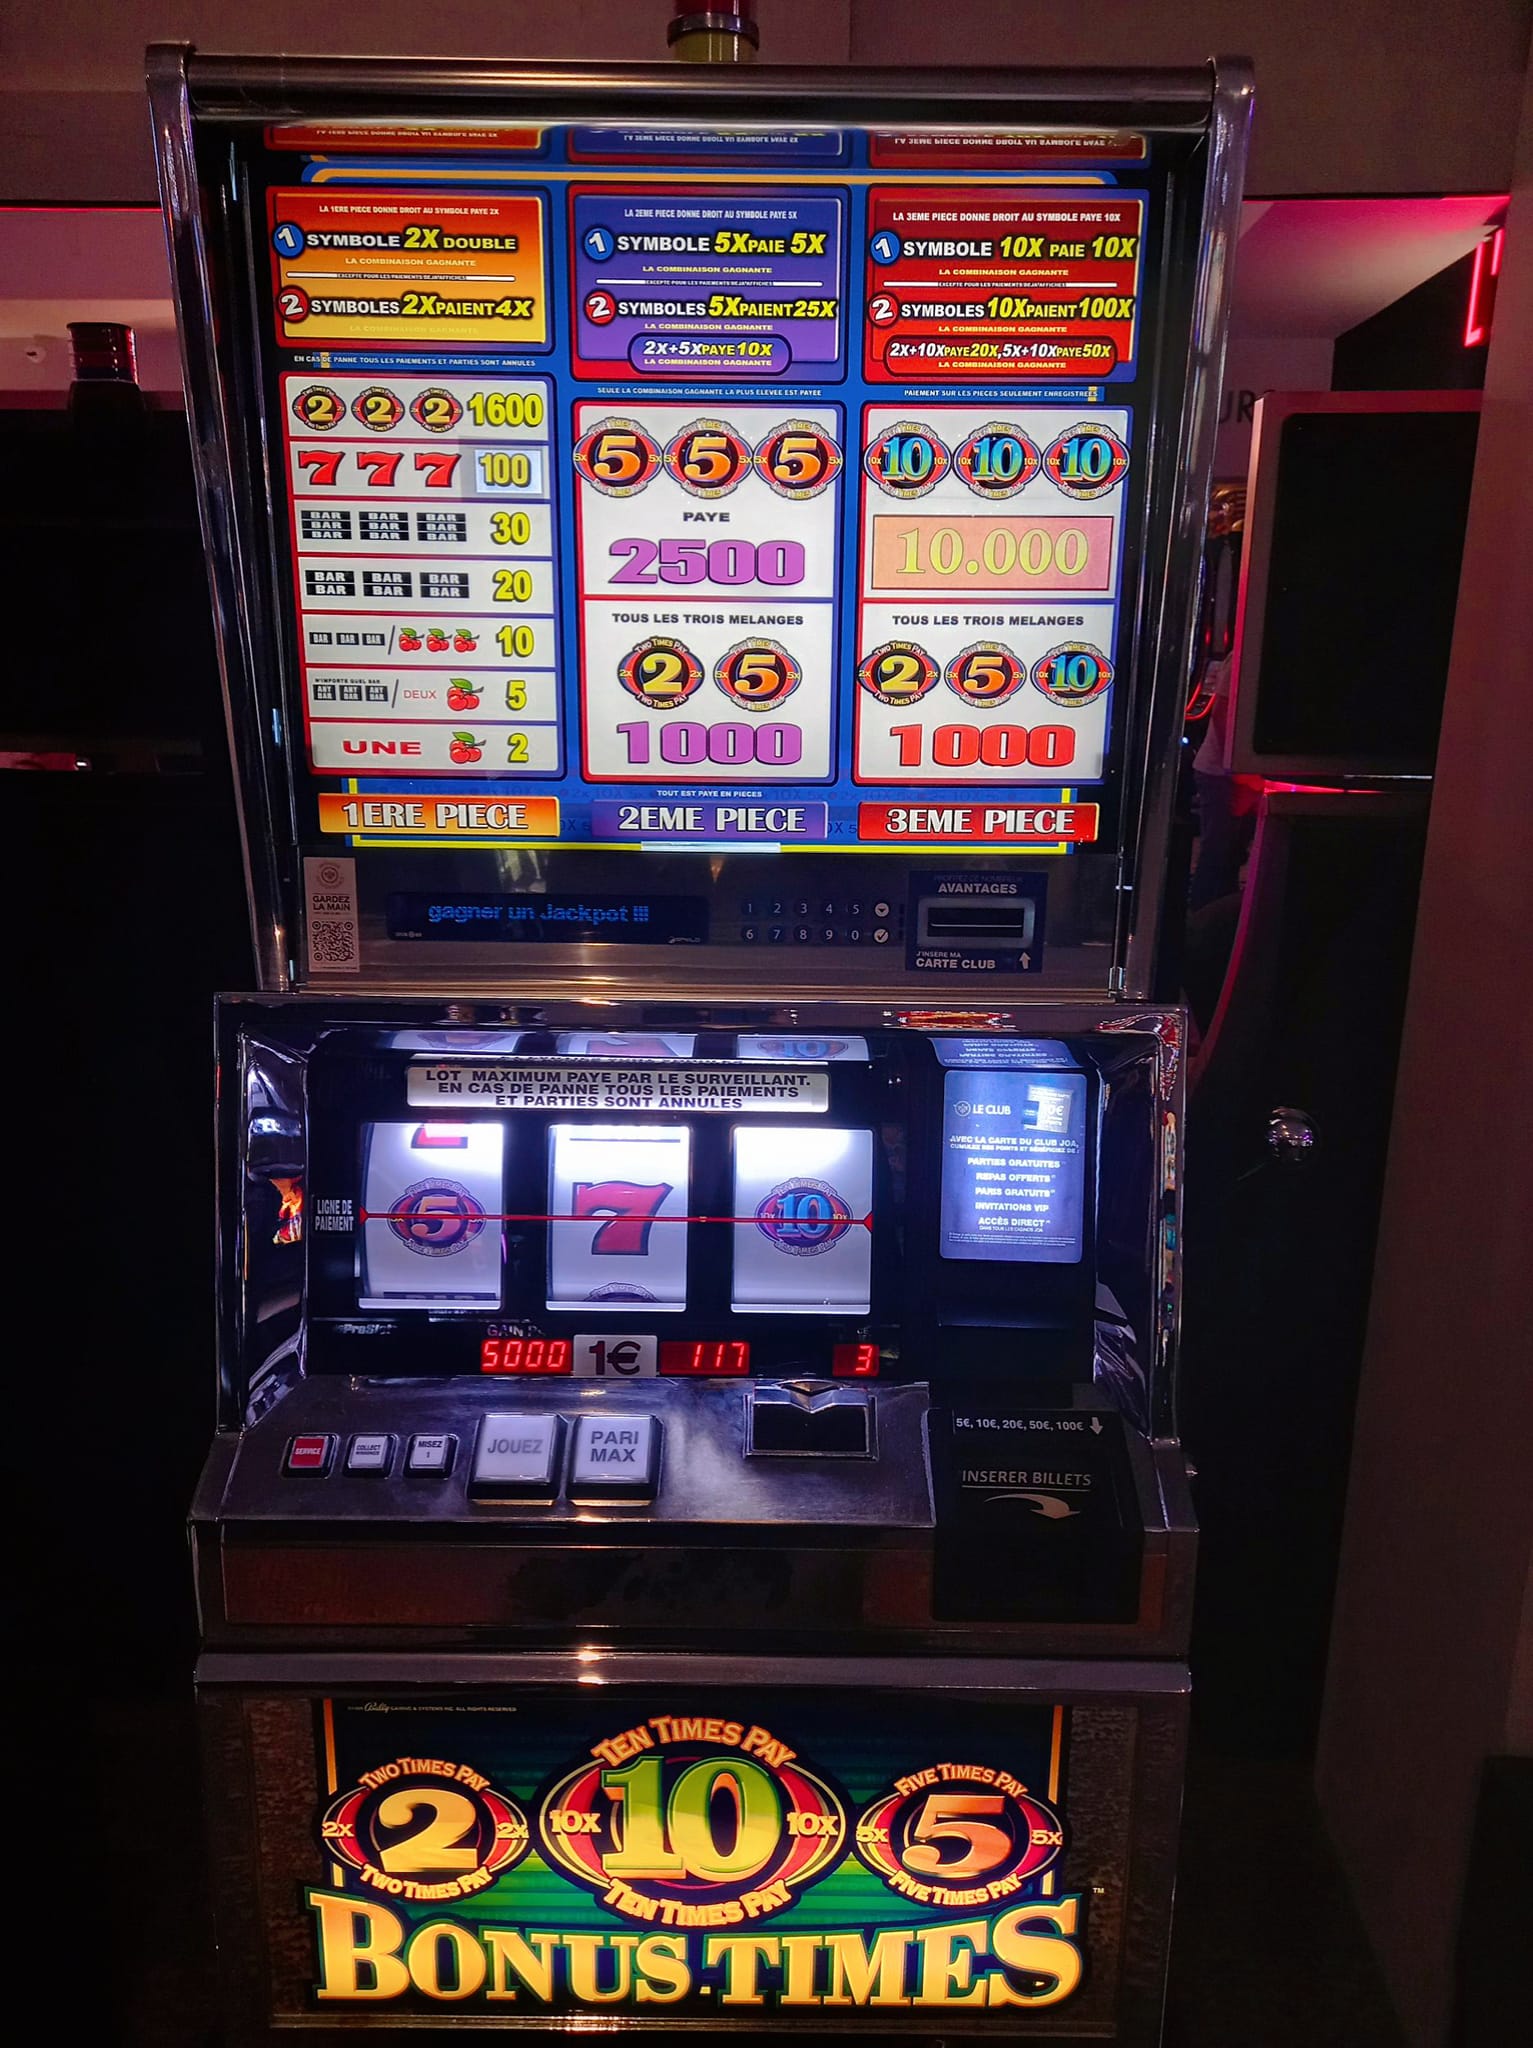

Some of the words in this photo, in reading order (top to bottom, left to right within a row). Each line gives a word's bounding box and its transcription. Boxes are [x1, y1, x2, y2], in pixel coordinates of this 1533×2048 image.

[893, 212, 904, 221] LA
[907, 212, 930, 221] 3EME
[932, 212, 957, 221] PIECE
[960, 213, 990, 221] DONNE
[993, 213, 1019, 221] DROIT
[1022, 213, 1034, 221] AU
[1036, 213, 1077, 221] SYMBOLE
[1080, 213, 1101, 221] PAYE
[1104, 213, 1120, 221] 10X
[278, 228, 295, 248] 1
[307, 235, 400, 247] SYMBOLE
[403, 227, 440, 249] 2X
[443, 237, 515, 249] DOUBLE
[589, 233, 605, 252] 1
[617, 236, 709, 251] SYMBOLE
[714, 232, 749, 252] 5X
[749, 240, 784, 252] PAIE
[790, 233, 827, 254] 5X
[875, 238, 891, 257] 1
[904, 242, 992, 256] SYMBOLE
[1000, 237, 1044, 257] 10X
[1050, 244, 1084, 257] PAIE
[1092, 237, 1135, 257] 10X
[281, 295, 303, 315] 2
[311, 301, 399, 314] SYMBOLES
[468, 392, 543, 427] 1600
[298, 450, 345, 485] 7
[357, 451, 404, 487] 7
[415, 452, 462, 487] 7
[479, 453, 531, 487] 100
[594, 436, 640, 481] 5
[684, 437, 731, 481] 5
[774, 437, 821, 481] 5
[883, 437, 933, 481] 10
[972, 437, 1023, 481] 10
[1060, 437, 1111, 481] 10
[491, 511, 531, 545] 30
[683, 512, 730, 522] PAYE
[609, 538, 805, 585] 2500
[896, 527, 1088, 575] 10.000
[493, 569, 532, 601] 20
[892, 615, 928, 625] TOUS
[934, 616, 958, 625] LES
[964, 616, 1004, 625] TROIS
[1009, 616, 1084, 626] MELANGES
[496, 625, 534, 657] 10
[404, 690, 436, 699] DEUX
[506, 680, 527, 711] 5
[343, 741, 422, 754] UNE
[508, 733, 528, 763] 2
[616, 721, 802, 765] 1000
[890, 724, 1076, 767] 1000
[342, 802, 426, 828] 1ERE
[436, 804, 528, 829] PIECE
[618, 806, 705, 831] 2EME
[716, 807, 806, 832] PIECE
[887, 809, 972, 833] 3EME
[984, 809, 1075, 833] PIECE
[938, 883, 1017, 894] AVANTAGES
[428, 905, 502, 922] gagner
[508, 906, 535, 920] un
[540, 904, 628, 925] Jackpot
[747, 904, 752, 913] 1
[774, 904, 781, 913] 2
[801, 904, 807, 913] 3
[825, 904, 833, 913] 4
[853, 905, 859, 914] 5
[746, 930, 753, 939] 6
[773, 930, 780, 939] 7
[800, 930, 807, 940] 8
[826, 930, 833, 940] 9
[916, 958, 958, 968] CARTE
[961, 960, 996, 968] CLUB
[425, 1070, 462, 1081] LOT
[473, 1071, 563, 1082] MAXIMUM
[567, 1072, 612, 1083] PAYE
[617, 1072, 653, 1084] PAR
[659, 1072, 680, 1084] LE
[685, 1073, 811, 1086] SURVEILLANT.
[438, 1083, 463, 1094] EN
[468, 1083, 503, 1094] CAS
[509, 1083, 532, 1094] DE
[539, 1083, 599, 1095] PANNE
[605, 1084, 654, 1096] TOUS
[659, 1085, 693, 1096] LES
[698, 1085, 798, 1097] PAIEMENTS
[495, 1095, 518, 1106] ET
[524, 1095, 599, 1107] PARTIES
[604, 1096, 651, 1108] SONT
[659, 1096, 742, 1109] ANNULES
[973, 1104, 984, 1114] LE
[317, 1200, 339, 1214] LIGNE
[342, 1200, 352, 1214] DE
[411, 1196, 462, 1241] 5
[571, 1180, 674, 1256] 7
[777, 1194, 832, 1238] 10
[1034, 1204, 1049, 1212] VIP
[315, 1216, 354, 1231] PAIEMENT
[483, 1341, 567, 1367] 5000
[589, 1340, 641, 1375] 1€
[693, 1343, 745, 1368] 117
[855, 1345, 873, 1371] 3
[591, 1431, 639, 1445] PARI
[1056, 1422, 1083, 1431] 100€
[487, 1438, 542, 1454] JOUEZ
[590, 1449, 635, 1462] MAX
[962, 1470, 1027, 1483] INSERER
[1033, 1472, 1091, 1486] BILLETS
[591, 1726, 655, 1766] TEN
[650, 1715, 742, 1746] TIMES
[740, 1725, 797, 1769] PAY
[358, 1763, 399, 1791] TWO
[397, 1757, 456, 1778] TIMES
[457, 1764, 490, 1792] PAY
[894, 1768, 938, 1797] FIVE
[937, 1763, 995, 1785] TIMES
[995, 1771, 1028, 1798] PAY
[378, 1789, 478, 1873] 2
[601, 1756, 782, 1880] 10
[902, 1794, 1014, 1878] 5
[309, 1889, 692, 2003] BONUS
[706, 1898, 1084, 2008] TIMES
